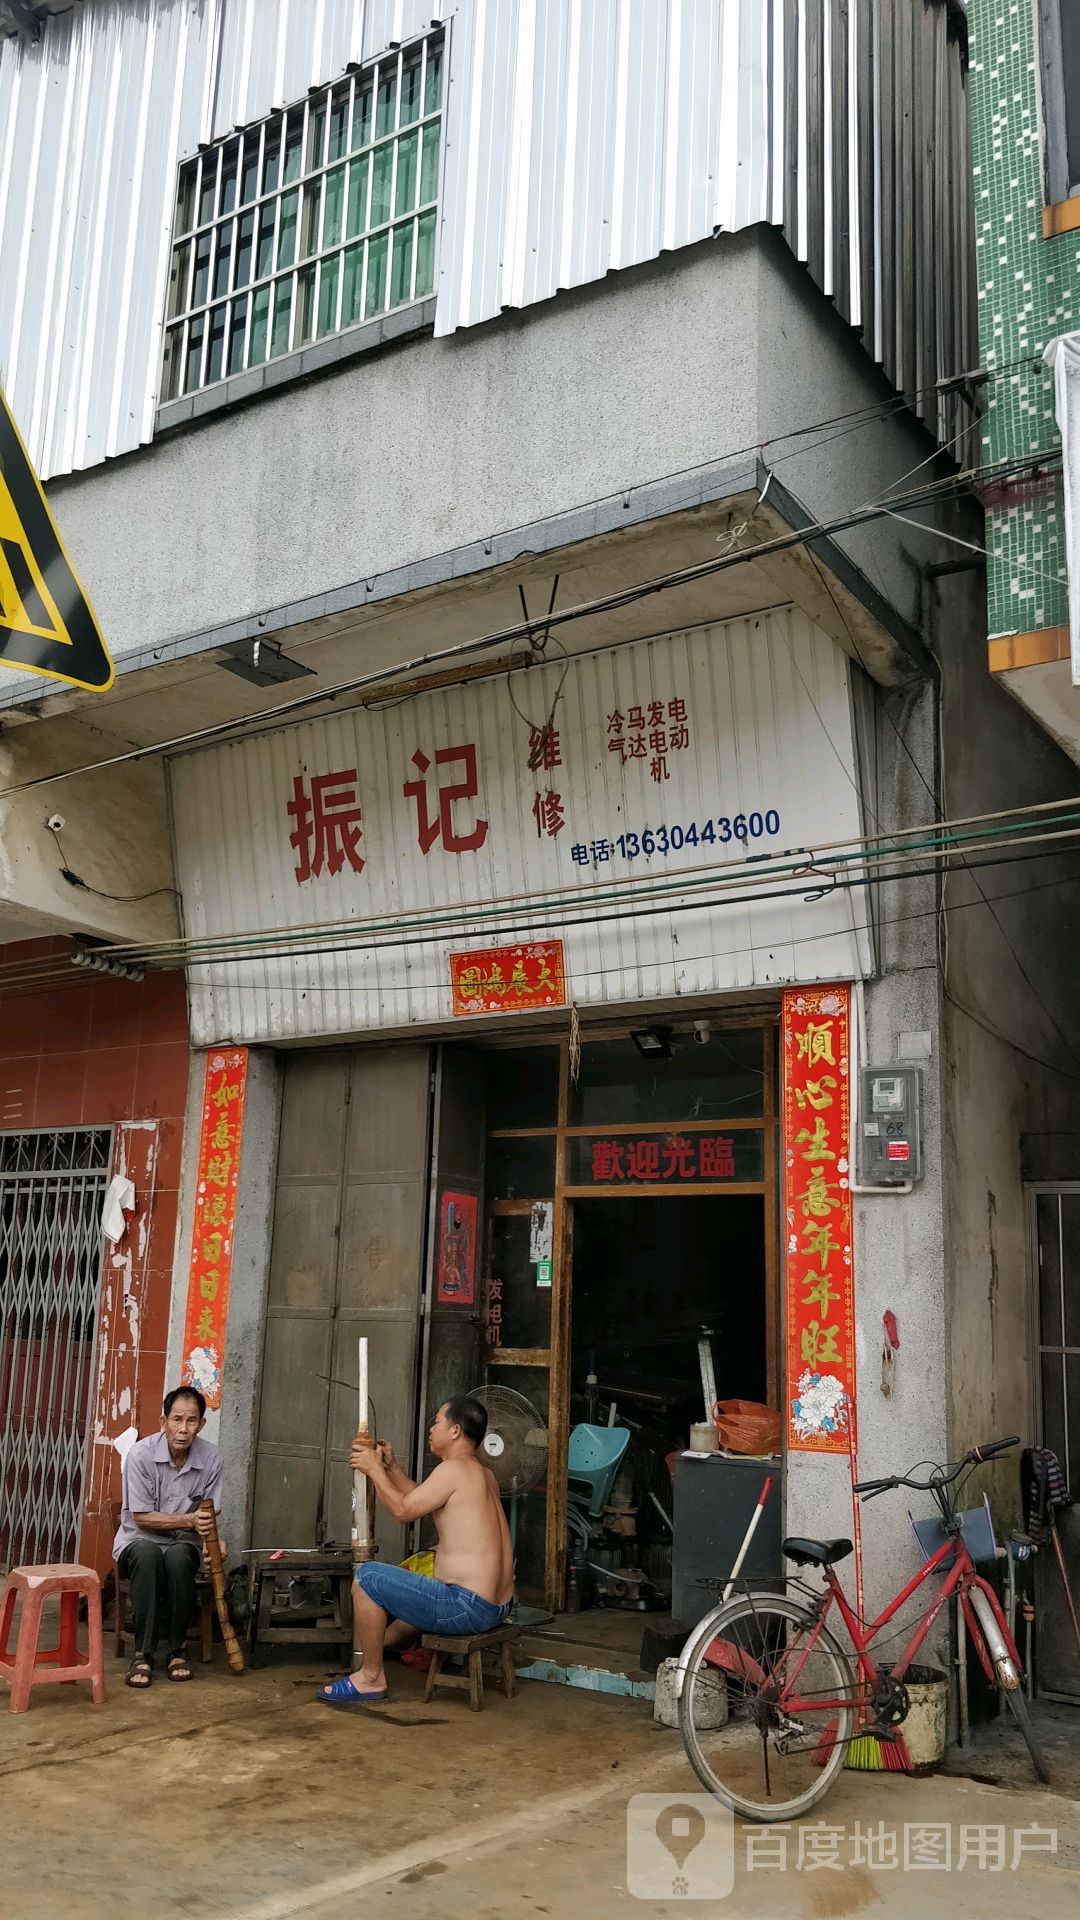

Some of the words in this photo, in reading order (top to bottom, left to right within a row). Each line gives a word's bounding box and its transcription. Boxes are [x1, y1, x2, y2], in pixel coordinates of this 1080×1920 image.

[287, 744, 488, 882] 振记
[528, 727, 565, 838] 维修
[591, 1136, 736, 1181] 歡迎光臨
[793, 1020, 844, 1370] 順心生意年年旺
